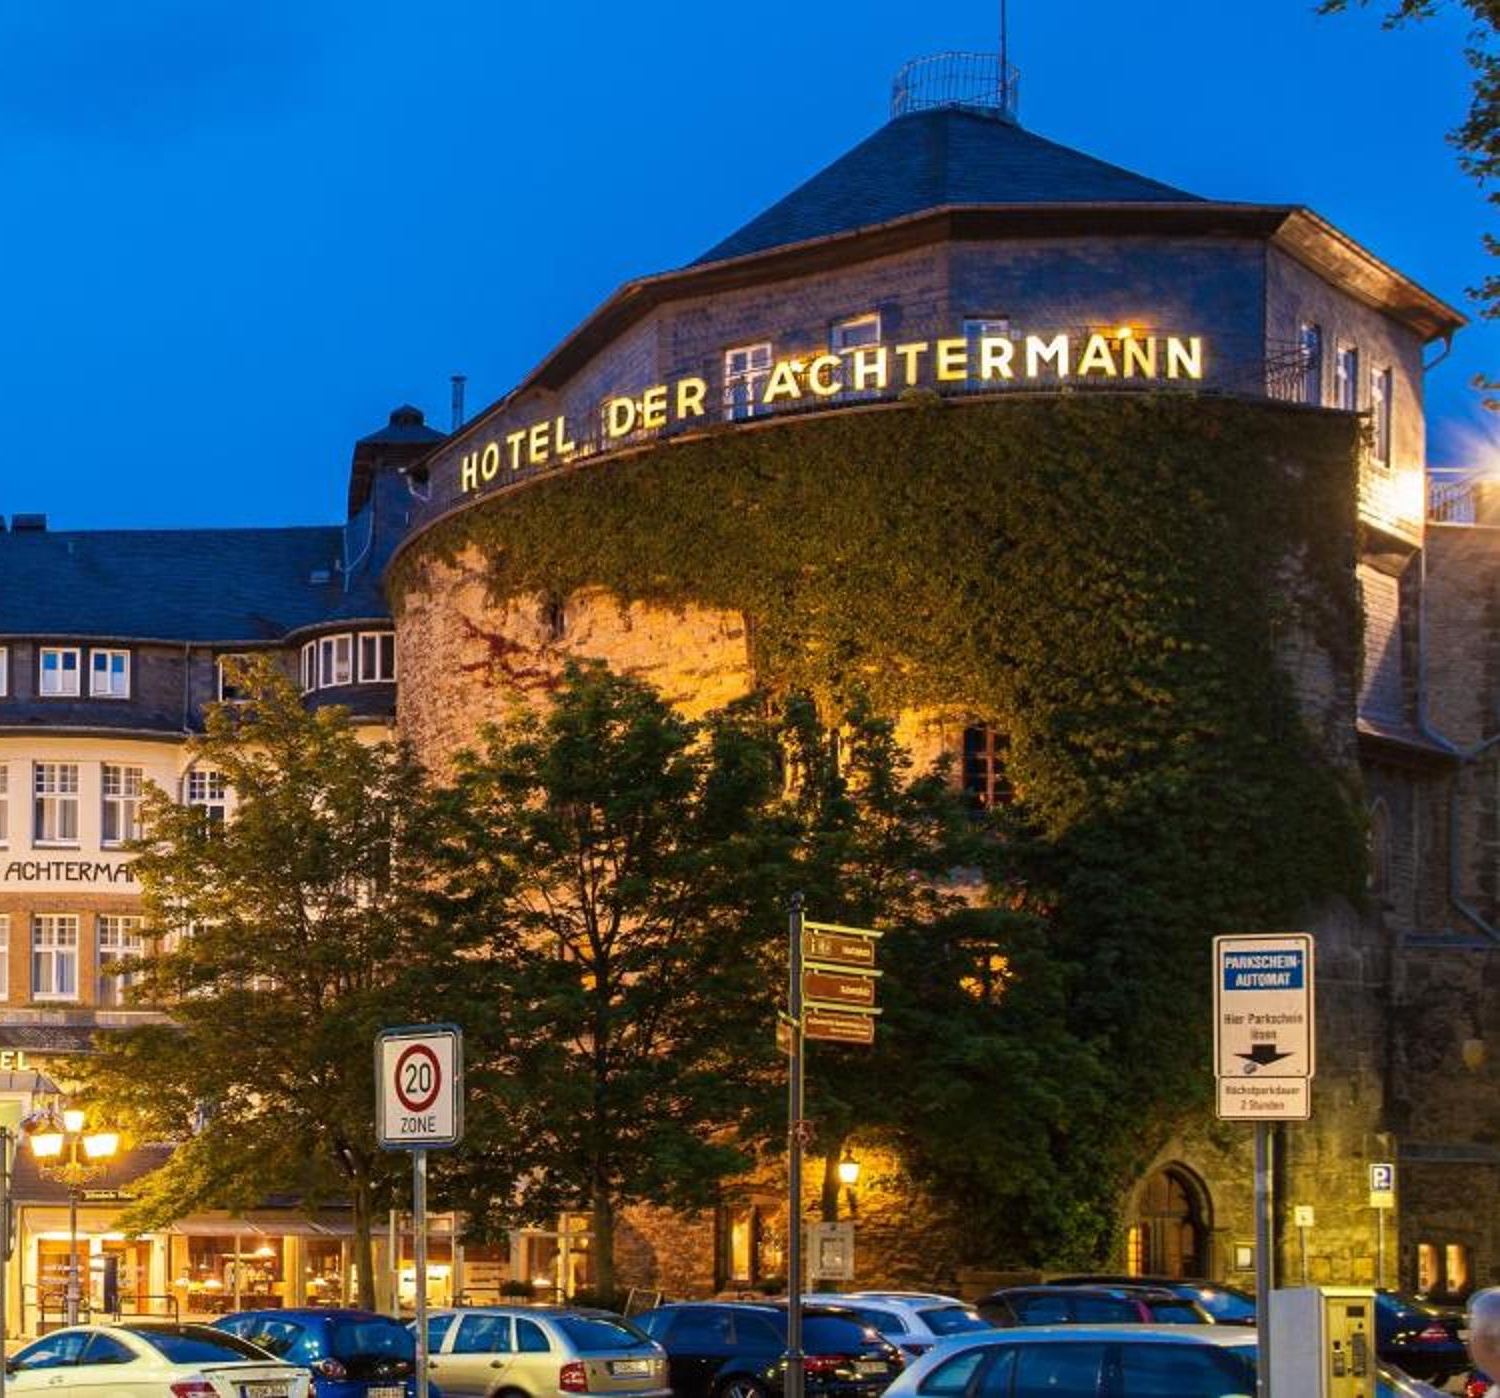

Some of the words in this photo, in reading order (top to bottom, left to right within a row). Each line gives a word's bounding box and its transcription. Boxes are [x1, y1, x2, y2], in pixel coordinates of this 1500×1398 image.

[460, 418, 575, 492] HOTEL
[608, 376, 706, 439] DER
[762, 333, 1203, 405] ACHTERMANN
[1235, 973, 1291, 987] AUTOMAT
[1224, 1013, 1244, 1025] Hier
[1247, 1013, 1303, 1025] Parkschein
[405, 1062, 431, 1093] 20
[1249, 1099, 1284, 1110] Stunden
[400, 1116, 436, 1133] ZONE
[1373, 1167, 1388, 1188] P
